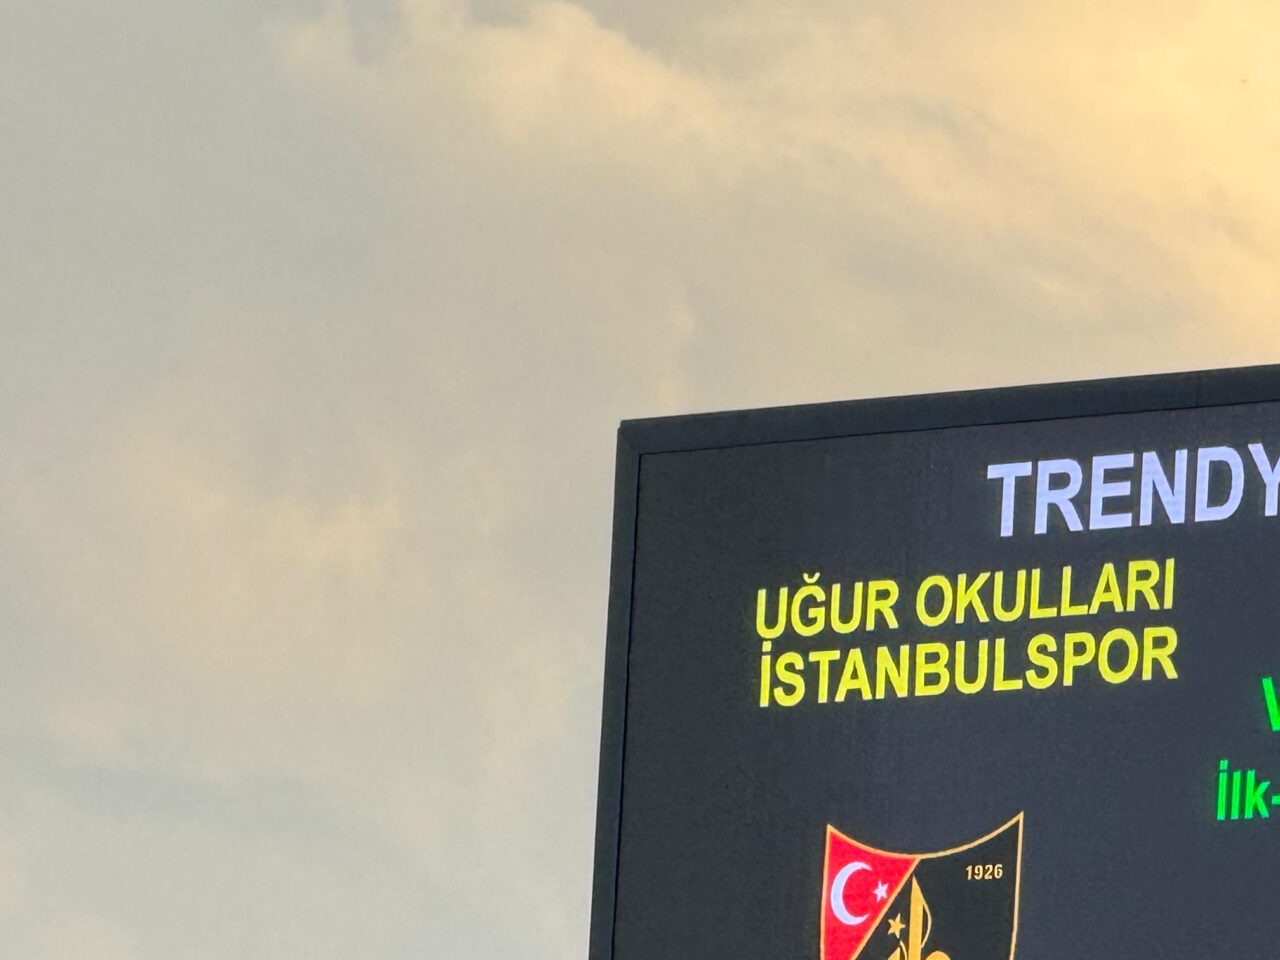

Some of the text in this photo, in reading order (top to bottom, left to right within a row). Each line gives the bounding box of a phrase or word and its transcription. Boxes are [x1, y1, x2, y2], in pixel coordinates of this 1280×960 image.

[755, 557, 1176, 640] UĞUR OKULLARI
[759, 625, 1180, 709] İSTANBULSPOR
[966, 864, 1003, 880] 1926
